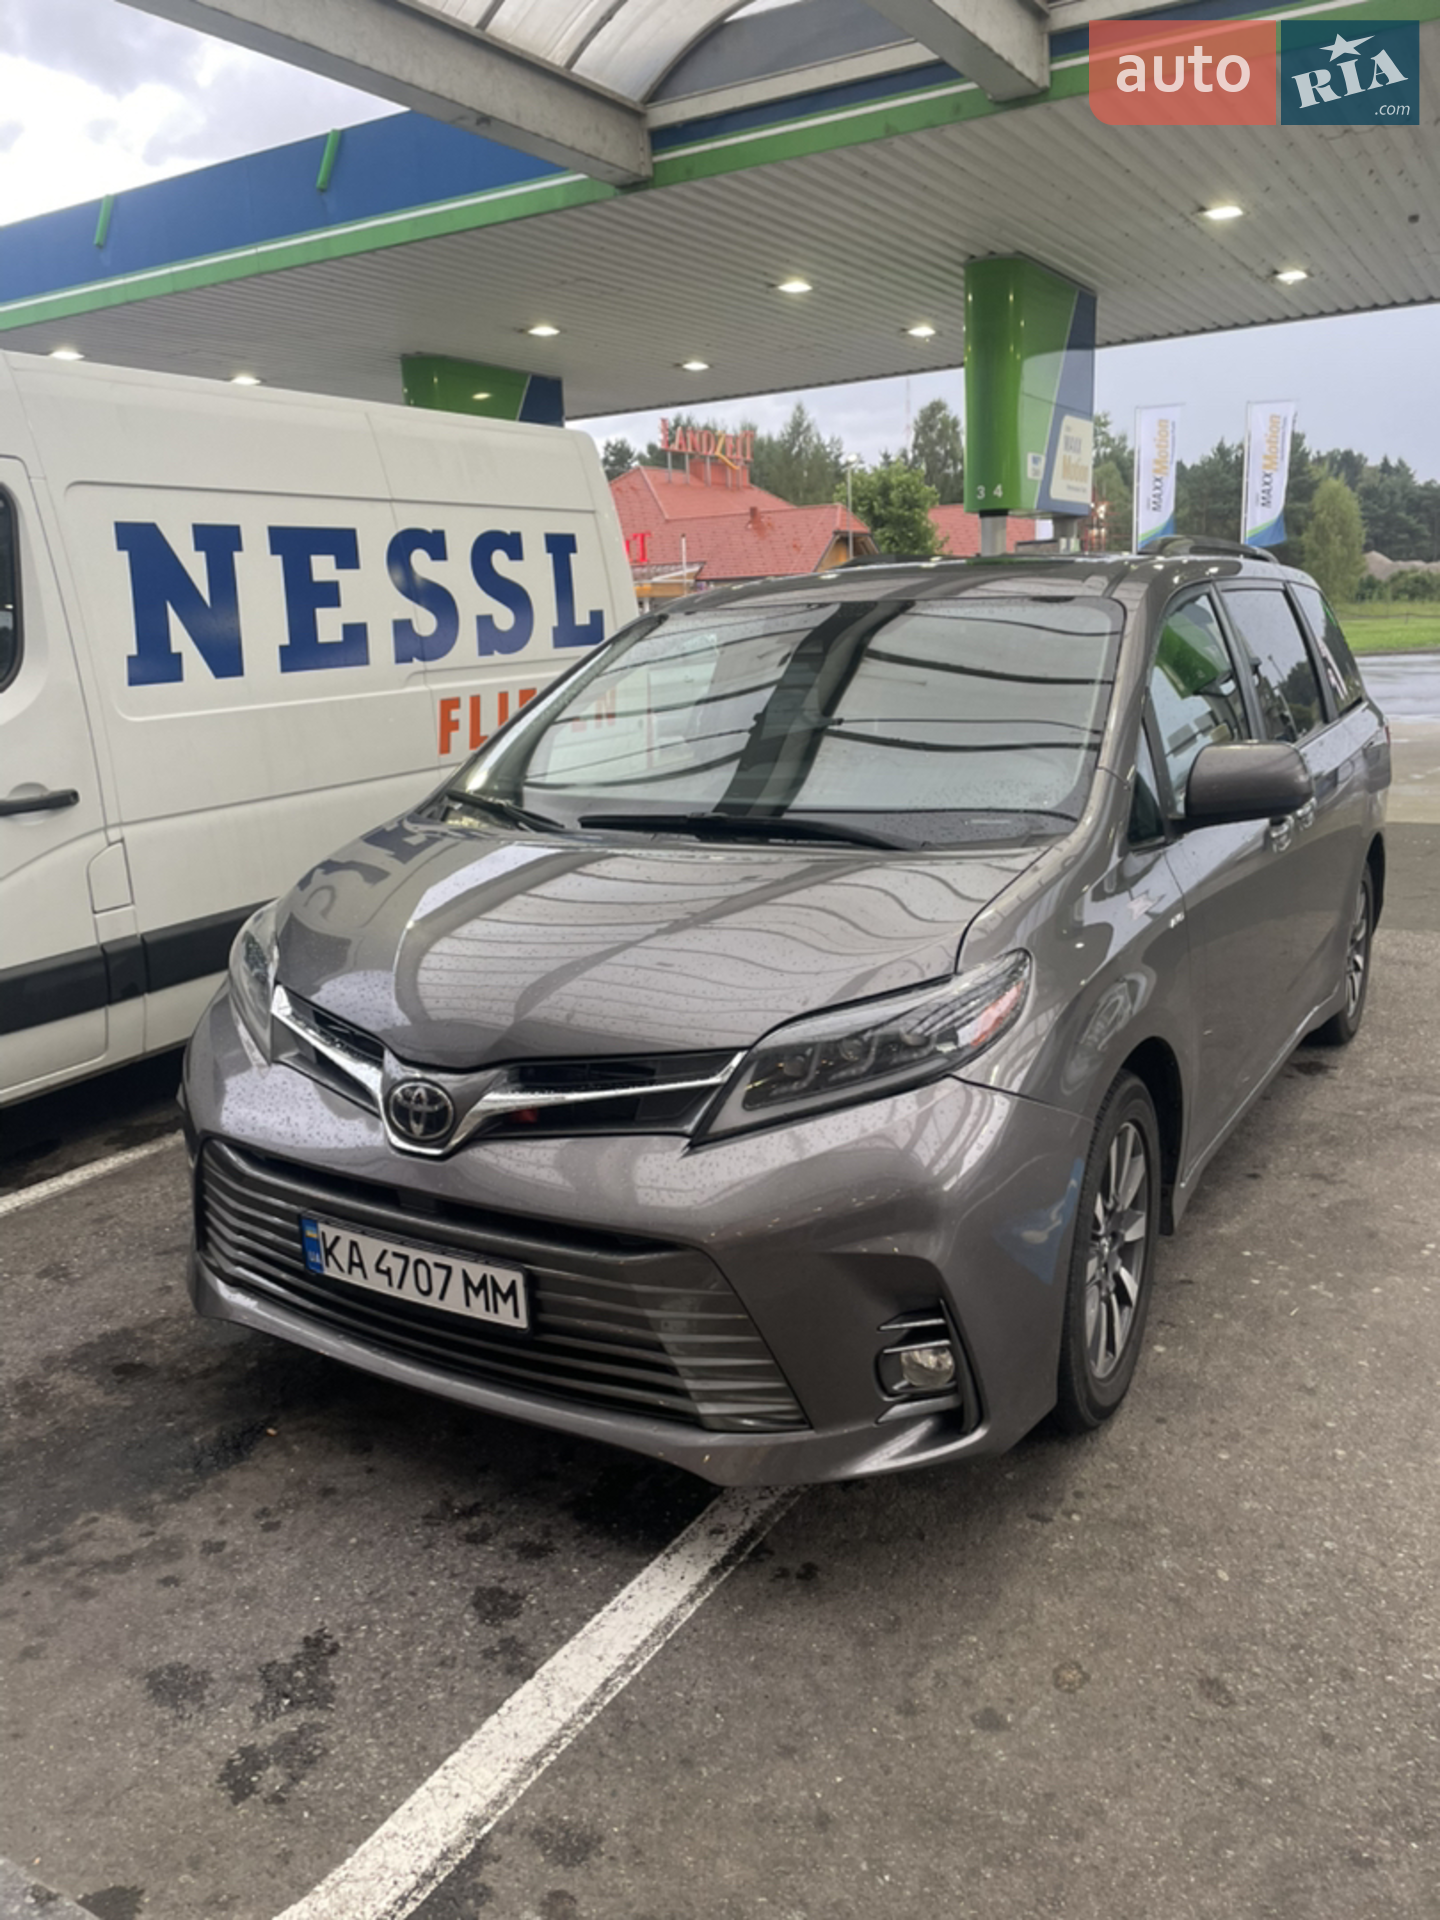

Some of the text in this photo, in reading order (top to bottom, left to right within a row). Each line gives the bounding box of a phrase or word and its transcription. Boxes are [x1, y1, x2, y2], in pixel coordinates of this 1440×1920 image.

[976, 483, 1003, 499] 3 4
[114, 521, 605, 686] NESSL
[321, 1231, 520, 1319] KA 4707 MM
